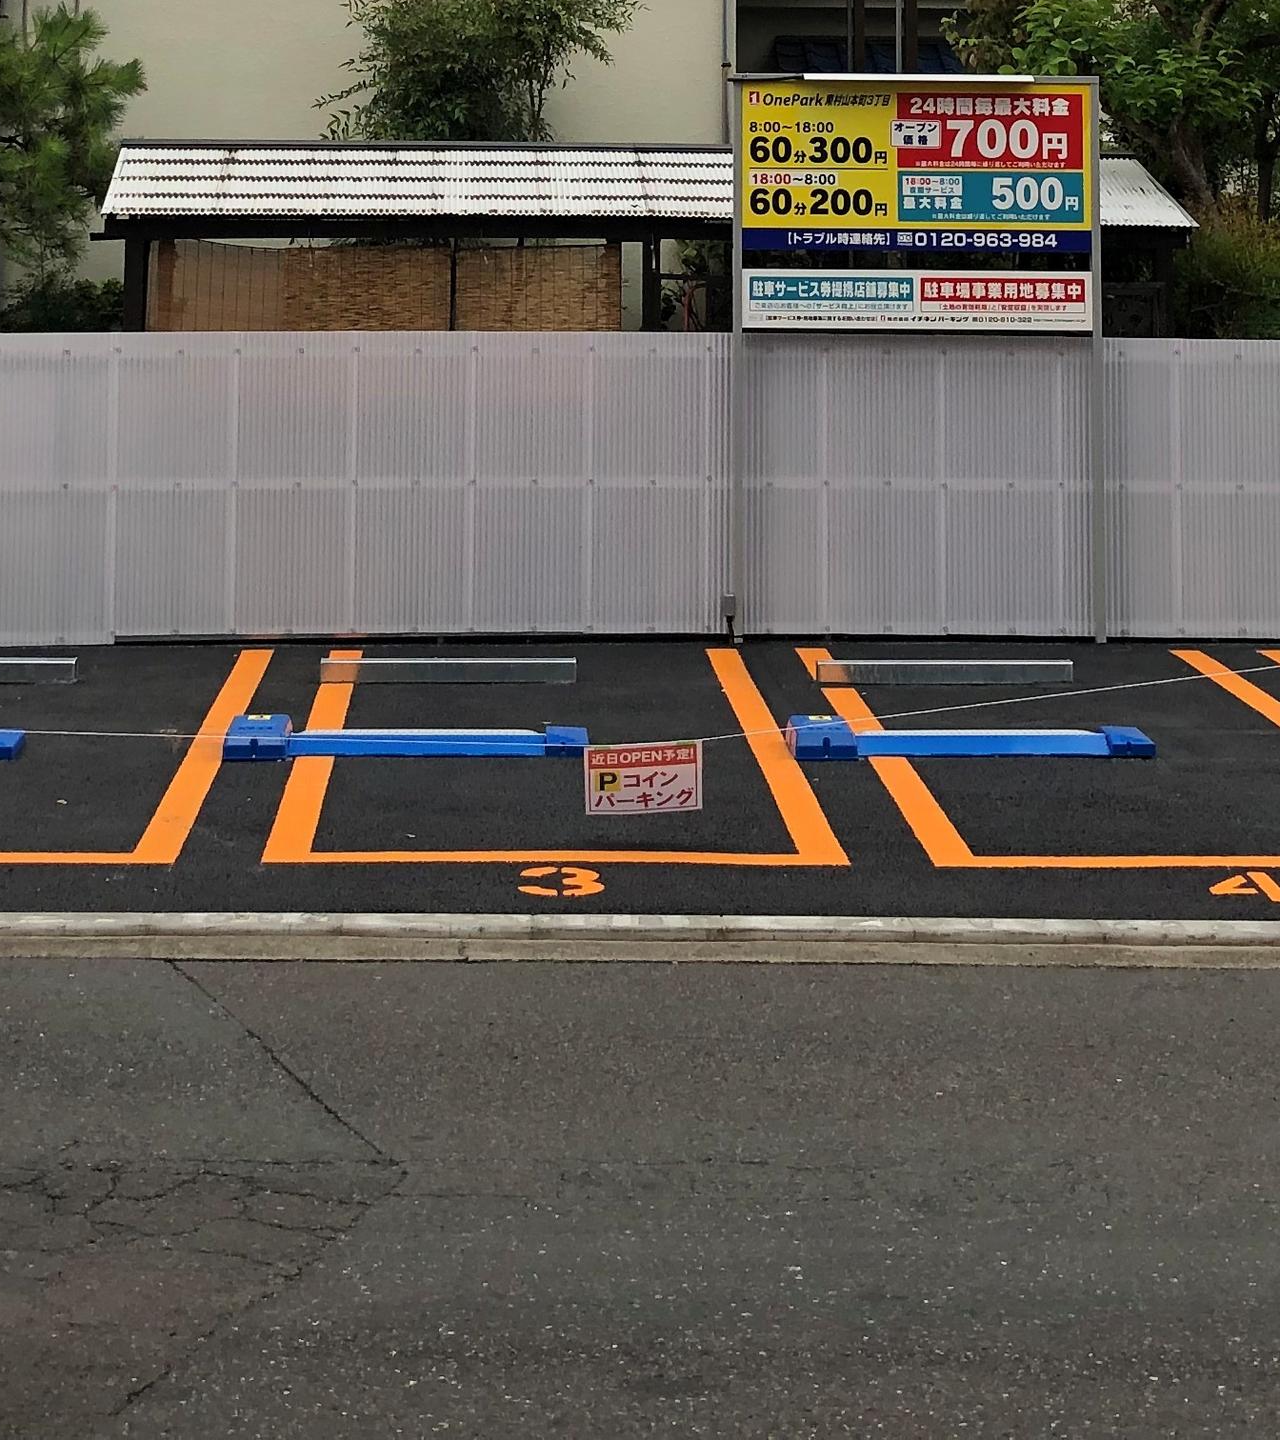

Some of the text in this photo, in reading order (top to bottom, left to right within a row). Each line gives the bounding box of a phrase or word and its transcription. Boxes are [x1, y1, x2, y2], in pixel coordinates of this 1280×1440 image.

[763, 93, 823, 107] OnePark
[894, 122, 938, 134] オープン
[946, 118, 1068, 160] 700円
[992, 177, 1079, 211] 500円
[915, 232, 1058, 248] 0120-963-984
[623, 771, 678, 788] コイン
[594, 787, 694, 808] パーキング
[518, 866, 606, 896] 3
